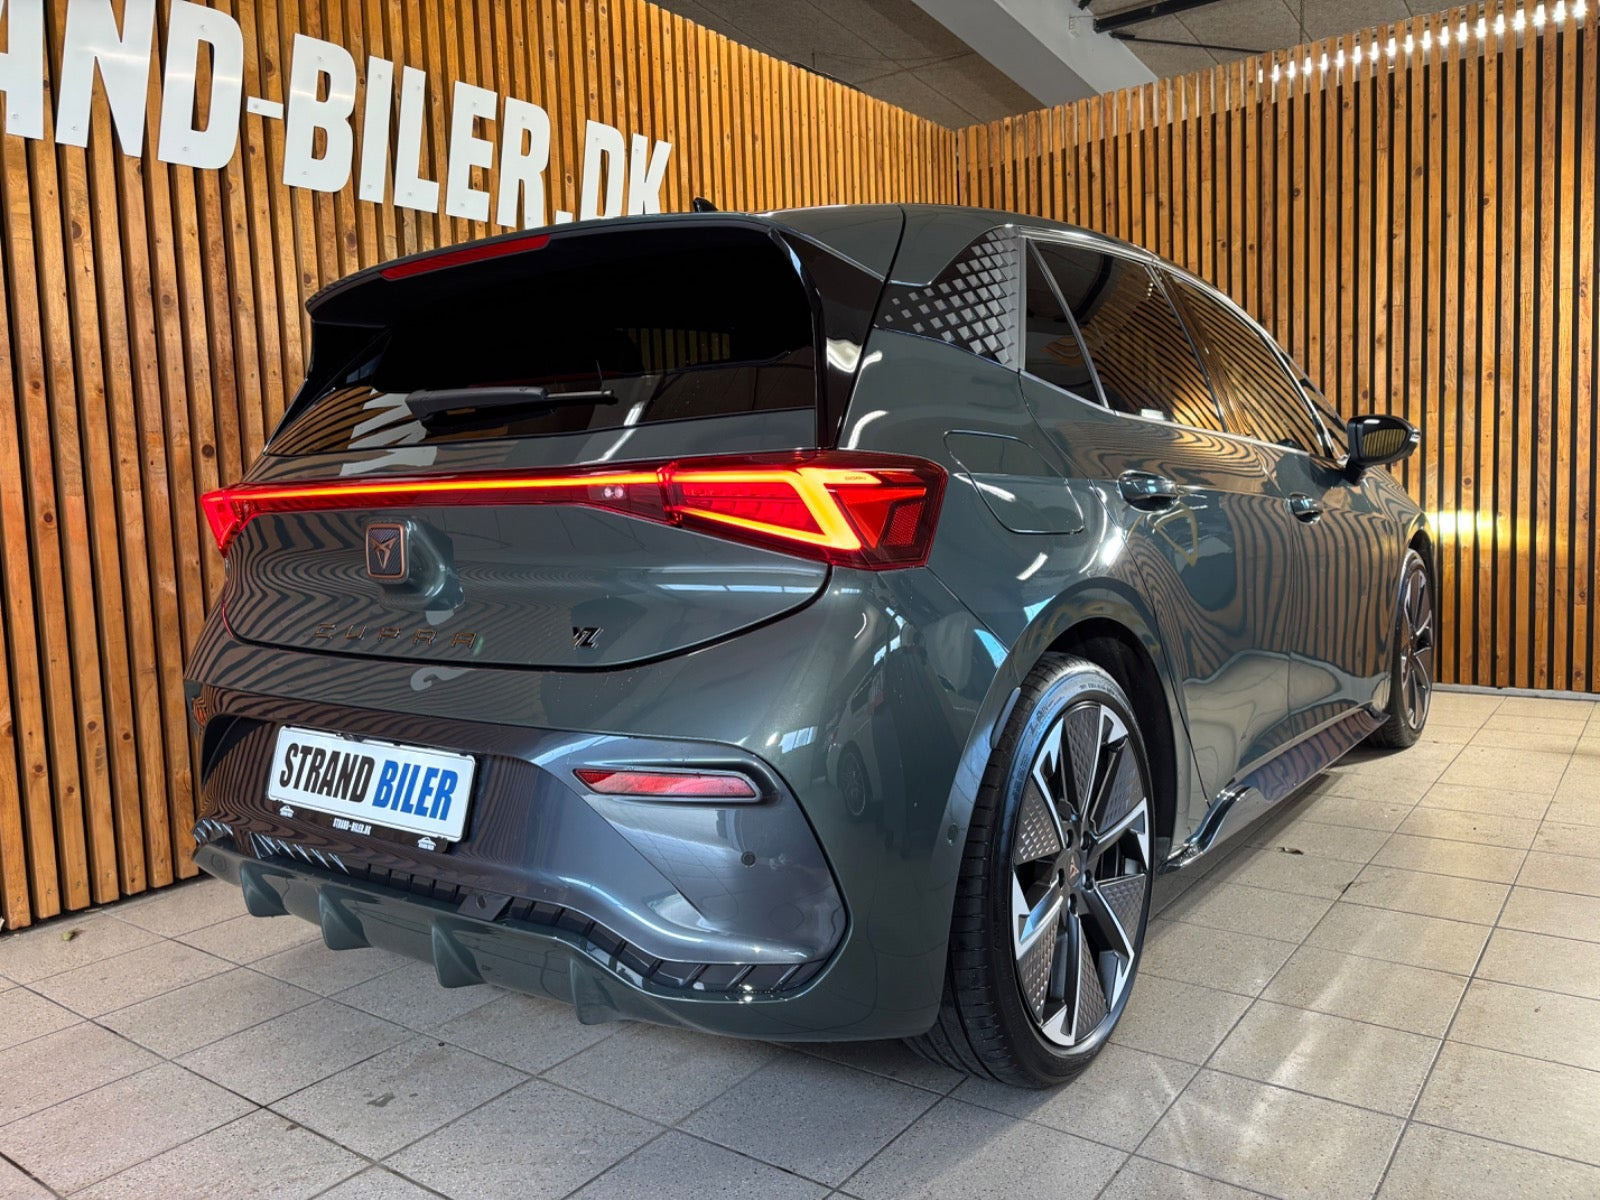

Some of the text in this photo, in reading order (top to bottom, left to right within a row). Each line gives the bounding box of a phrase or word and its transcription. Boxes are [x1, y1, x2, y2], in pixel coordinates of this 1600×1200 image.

[314, 623, 477, 648] CUPRA
[279, 743, 458, 821] STRAND BILER
